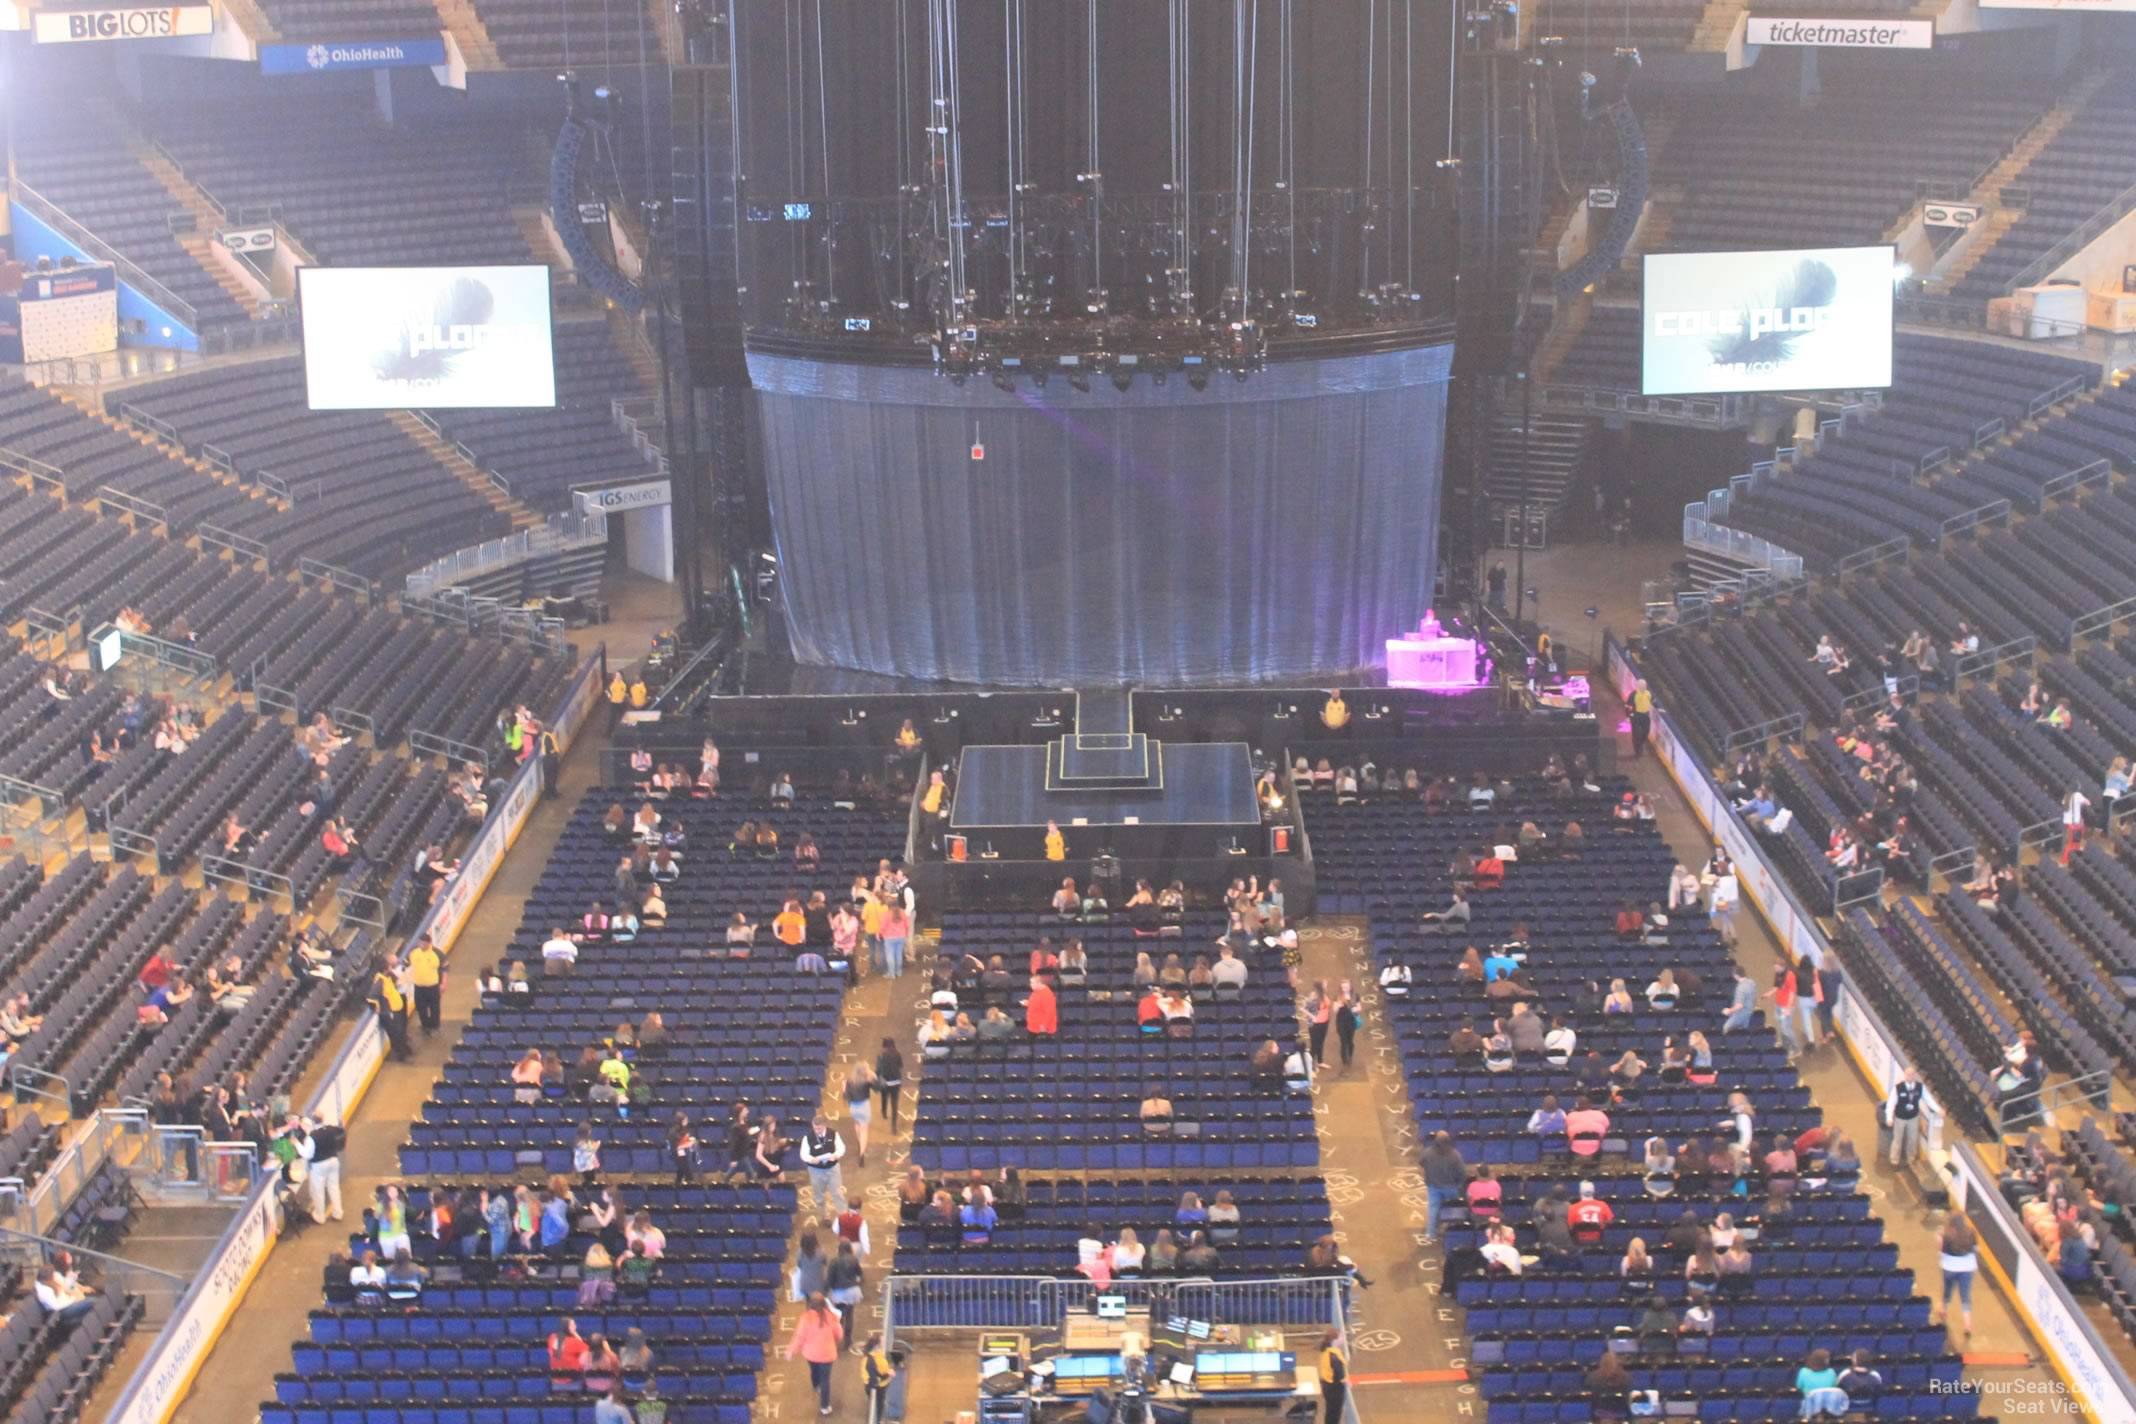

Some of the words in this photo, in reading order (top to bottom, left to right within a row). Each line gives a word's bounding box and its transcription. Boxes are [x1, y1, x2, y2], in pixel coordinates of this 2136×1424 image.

[1769, 22, 1900, 45] ticketmaster
[331, 46, 404, 63] OhioHealth
[1394, 1124, 1413, 1137] X
[1393, 1145, 1414, 1156] Y
[1418, 1258, 1438, 1271] C
[1438, 1308, 1455, 1322] E
[779, 1316, 796, 1331] E
[1444, 1338, 1461, 1350] F
[1450, 1358, 1467, 1369] G
[1457, 1384, 1476, 1394] G
[764, 1402, 780, 1418] H
[1458, 1401, 1473, 1416] H
